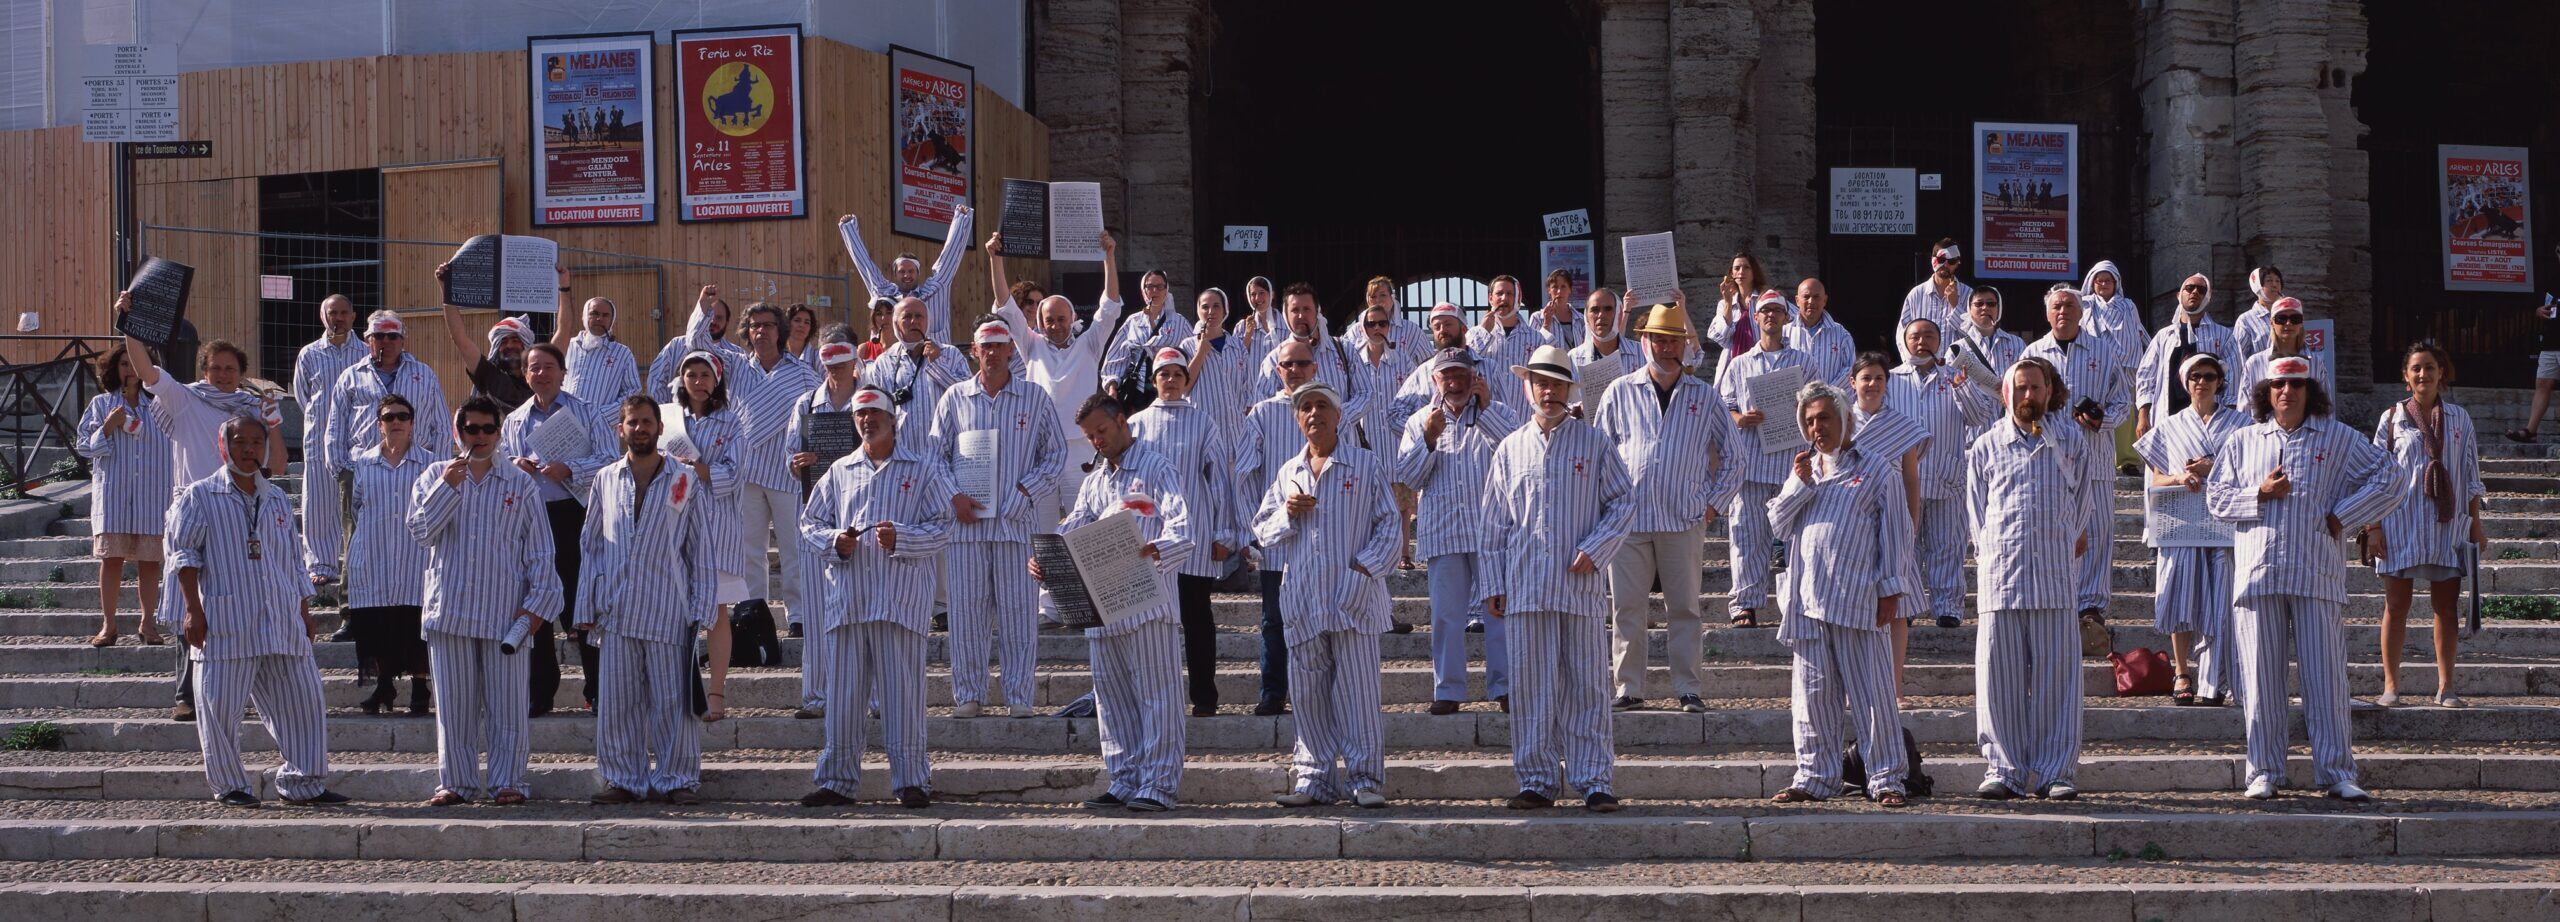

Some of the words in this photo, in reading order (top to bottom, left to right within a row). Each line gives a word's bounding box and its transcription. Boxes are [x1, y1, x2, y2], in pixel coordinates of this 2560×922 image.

[698, 47, 730, 60] Feria
[735, 49, 746, 57] du
[751, 44, 774, 57] Riz
[584, 88, 599, 96] 16
[144, 145, 152, 154] de
[153, 145, 178, 154] Tourisme
[696, 143, 703, 153] 9
[719, 140, 729, 152] 11
[591, 156, 629, 164] MENDOZA
[693, 159, 732, 171] Arles
[904, 167, 925, 178] Courses
[1854, 172, 1885, 180] LOCATION
[549, 210, 594, 220] LOCATION
[598, 208, 640, 218] OUVERTE
[696, 205, 742, 216] LOCATION
[746, 203, 790, 213] OUVERTE
[1852, 210, 1862, 220] 08
[1863, 210, 1872, 220] 91
[1873, 210, 1883, 220] 70
[1884, 210, 1893, 220] 03
[1895, 210, 1905, 220] 70
[1234, 230, 1263, 239] PORTES
[2452, 239, 2477, 247] Courses
[2478, 240, 2522, 249] Camarguaises
[1988, 260, 2027, 269] LOCATION
[2030, 261, 2067, 270] OUVERTE
[1100, 587, 1130, 601] ABSOLUTELY
